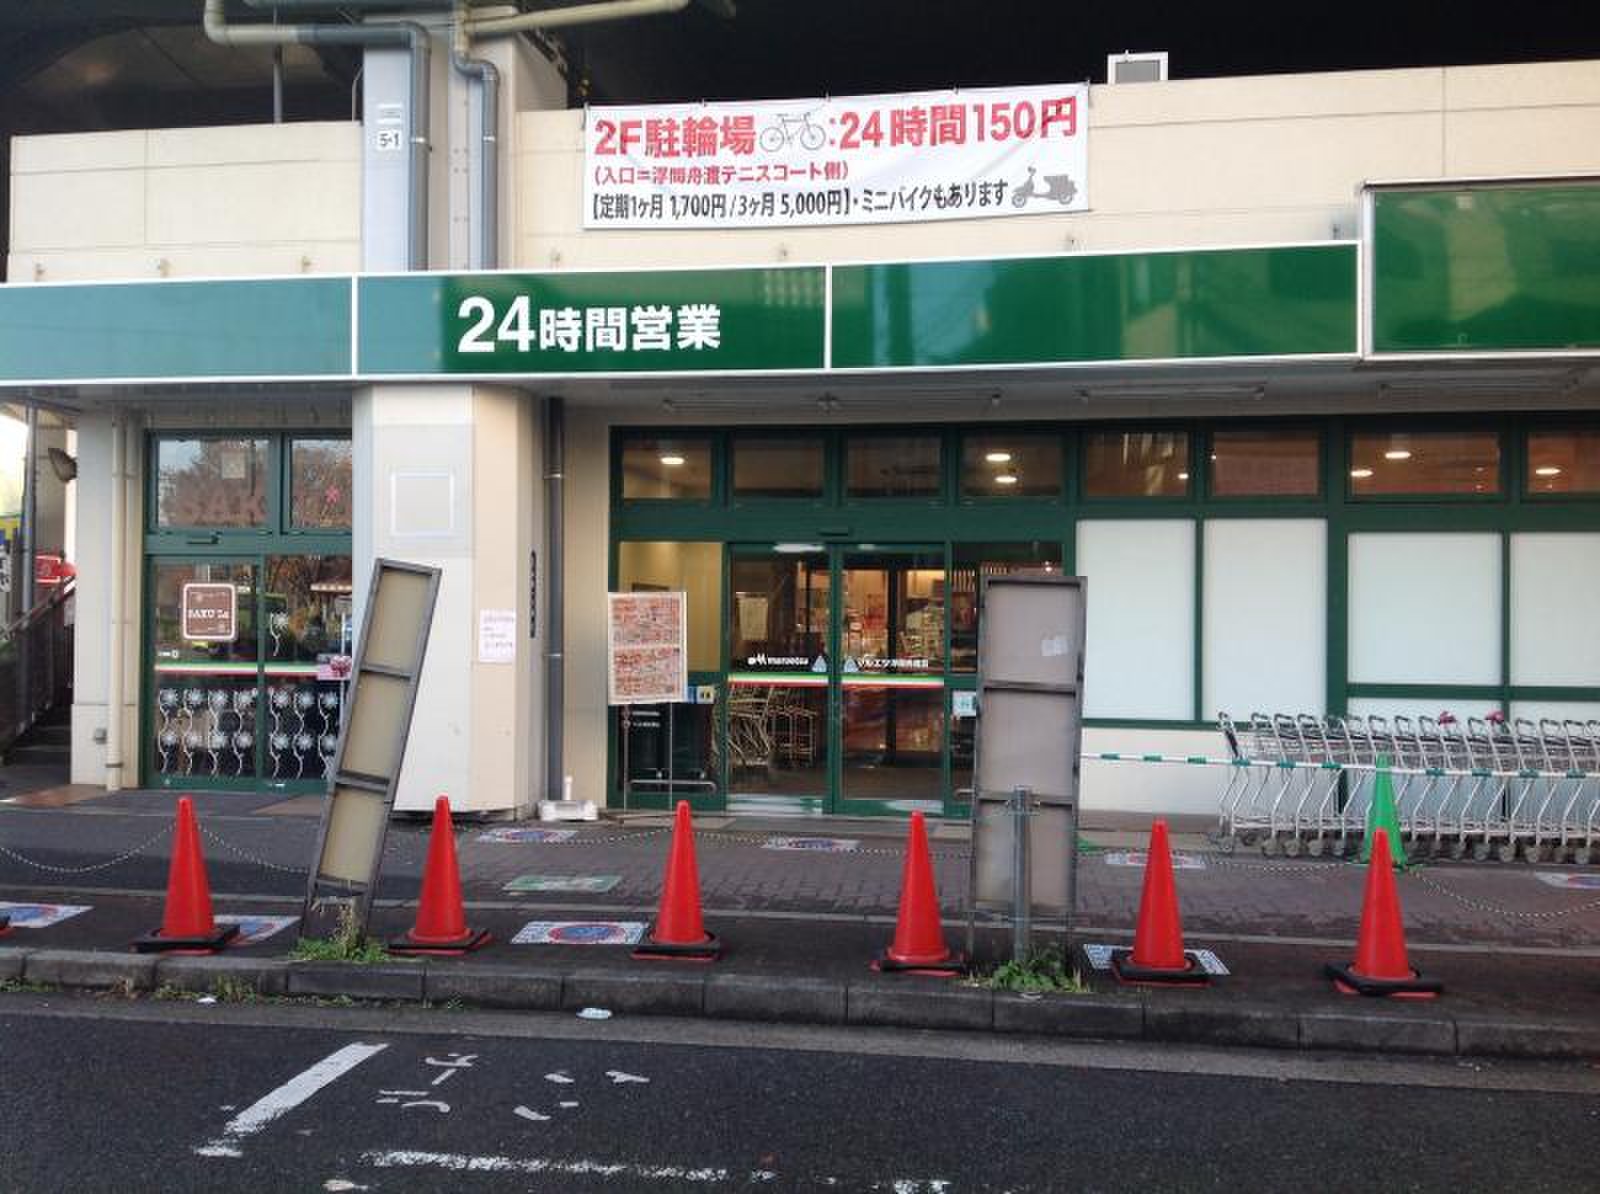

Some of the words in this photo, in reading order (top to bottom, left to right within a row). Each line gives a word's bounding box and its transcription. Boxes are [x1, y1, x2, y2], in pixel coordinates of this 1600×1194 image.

[595, 116, 756, 158] 2F駐輪場
[457, 295, 721, 352] 24時間営業
